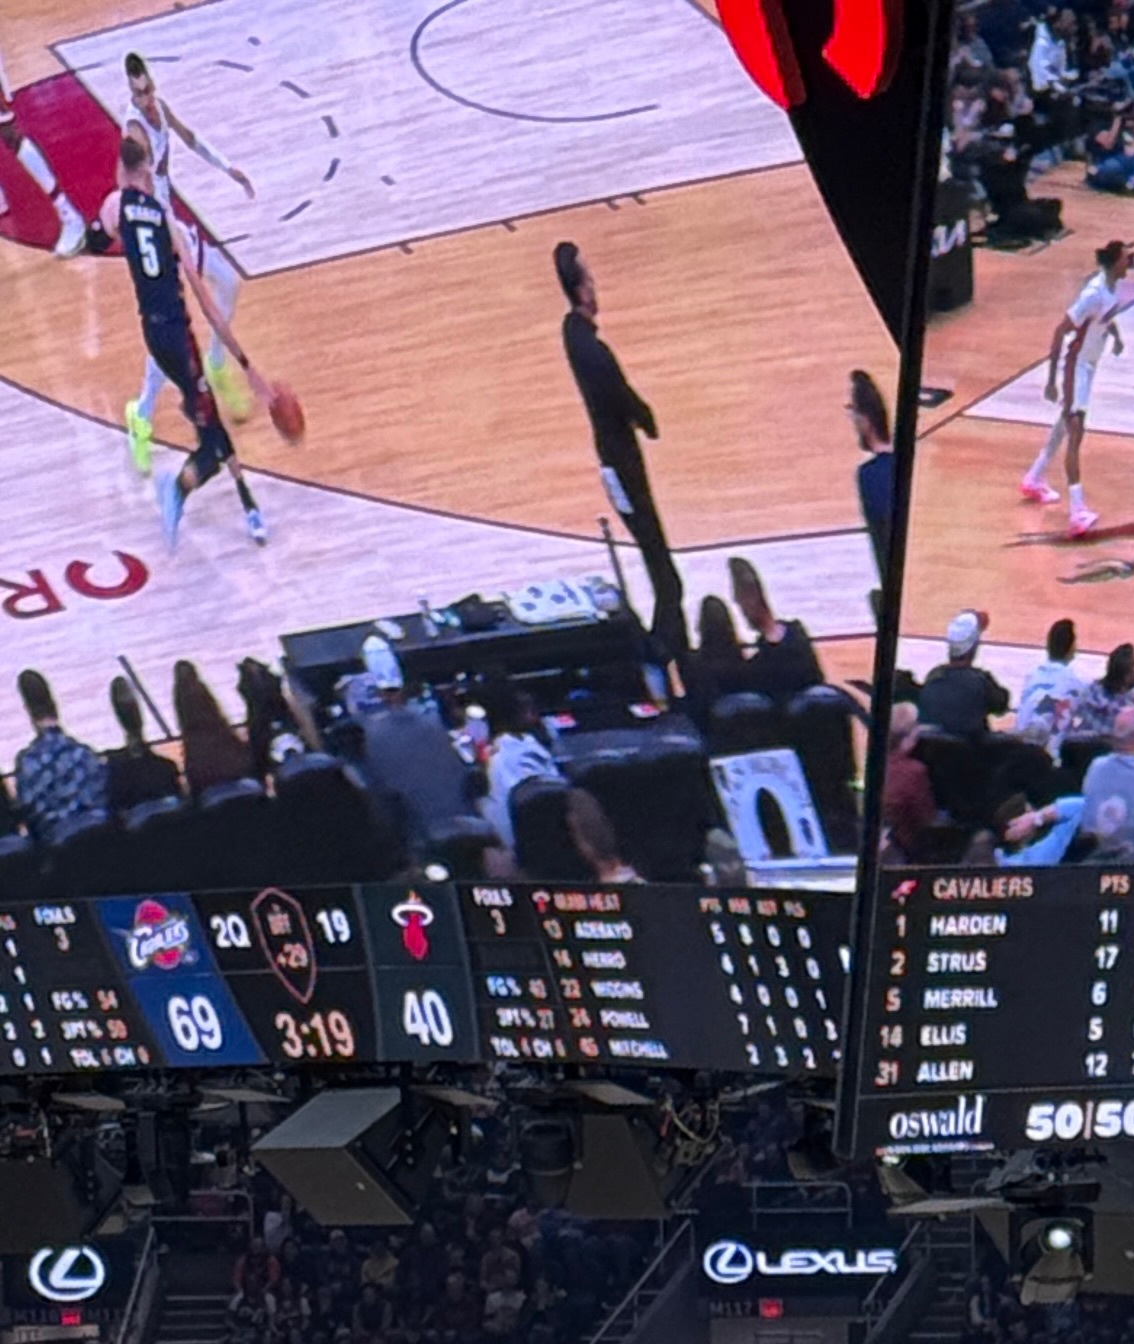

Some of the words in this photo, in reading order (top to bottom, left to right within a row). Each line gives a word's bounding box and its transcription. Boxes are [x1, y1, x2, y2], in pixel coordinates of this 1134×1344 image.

[136, 227, 160, 278] 5
[933, 877, 1034, 898] CAVALIERS
[1100, 874, 1130, 893] PTS
[210, 914, 251, 948] 2Q
[316, 909, 351, 943] 19
[896, 916, 906, 937] 1
[930, 915, 1007, 936] HARDEN
[1099, 909, 1119, 934] 11
[890, 950, 906, 975] 2
[926, 951, 987, 973] STRUS
[1095, 945, 1119, 969] 17
[886, 988, 901, 1012] 5
[923, 988, 998, 1009] MERRILL
[1091, 981, 1107, 1005] 6
[168, 996, 222, 1051] 69
[275, 1011, 355, 1058] 3:19
[404, 990, 453, 1046] 40
[920, 1025, 967, 1047] ELLIS
[1087, 1017, 1103, 1041] 5
[875, 1061, 898, 1087] 31
[916, 1061, 973, 1084] ALLEN
[1085, 1053, 1108, 1077] 12
[888, 1095, 986, 1140] oswald
[757, 1249, 898, 1275] LEXUS
